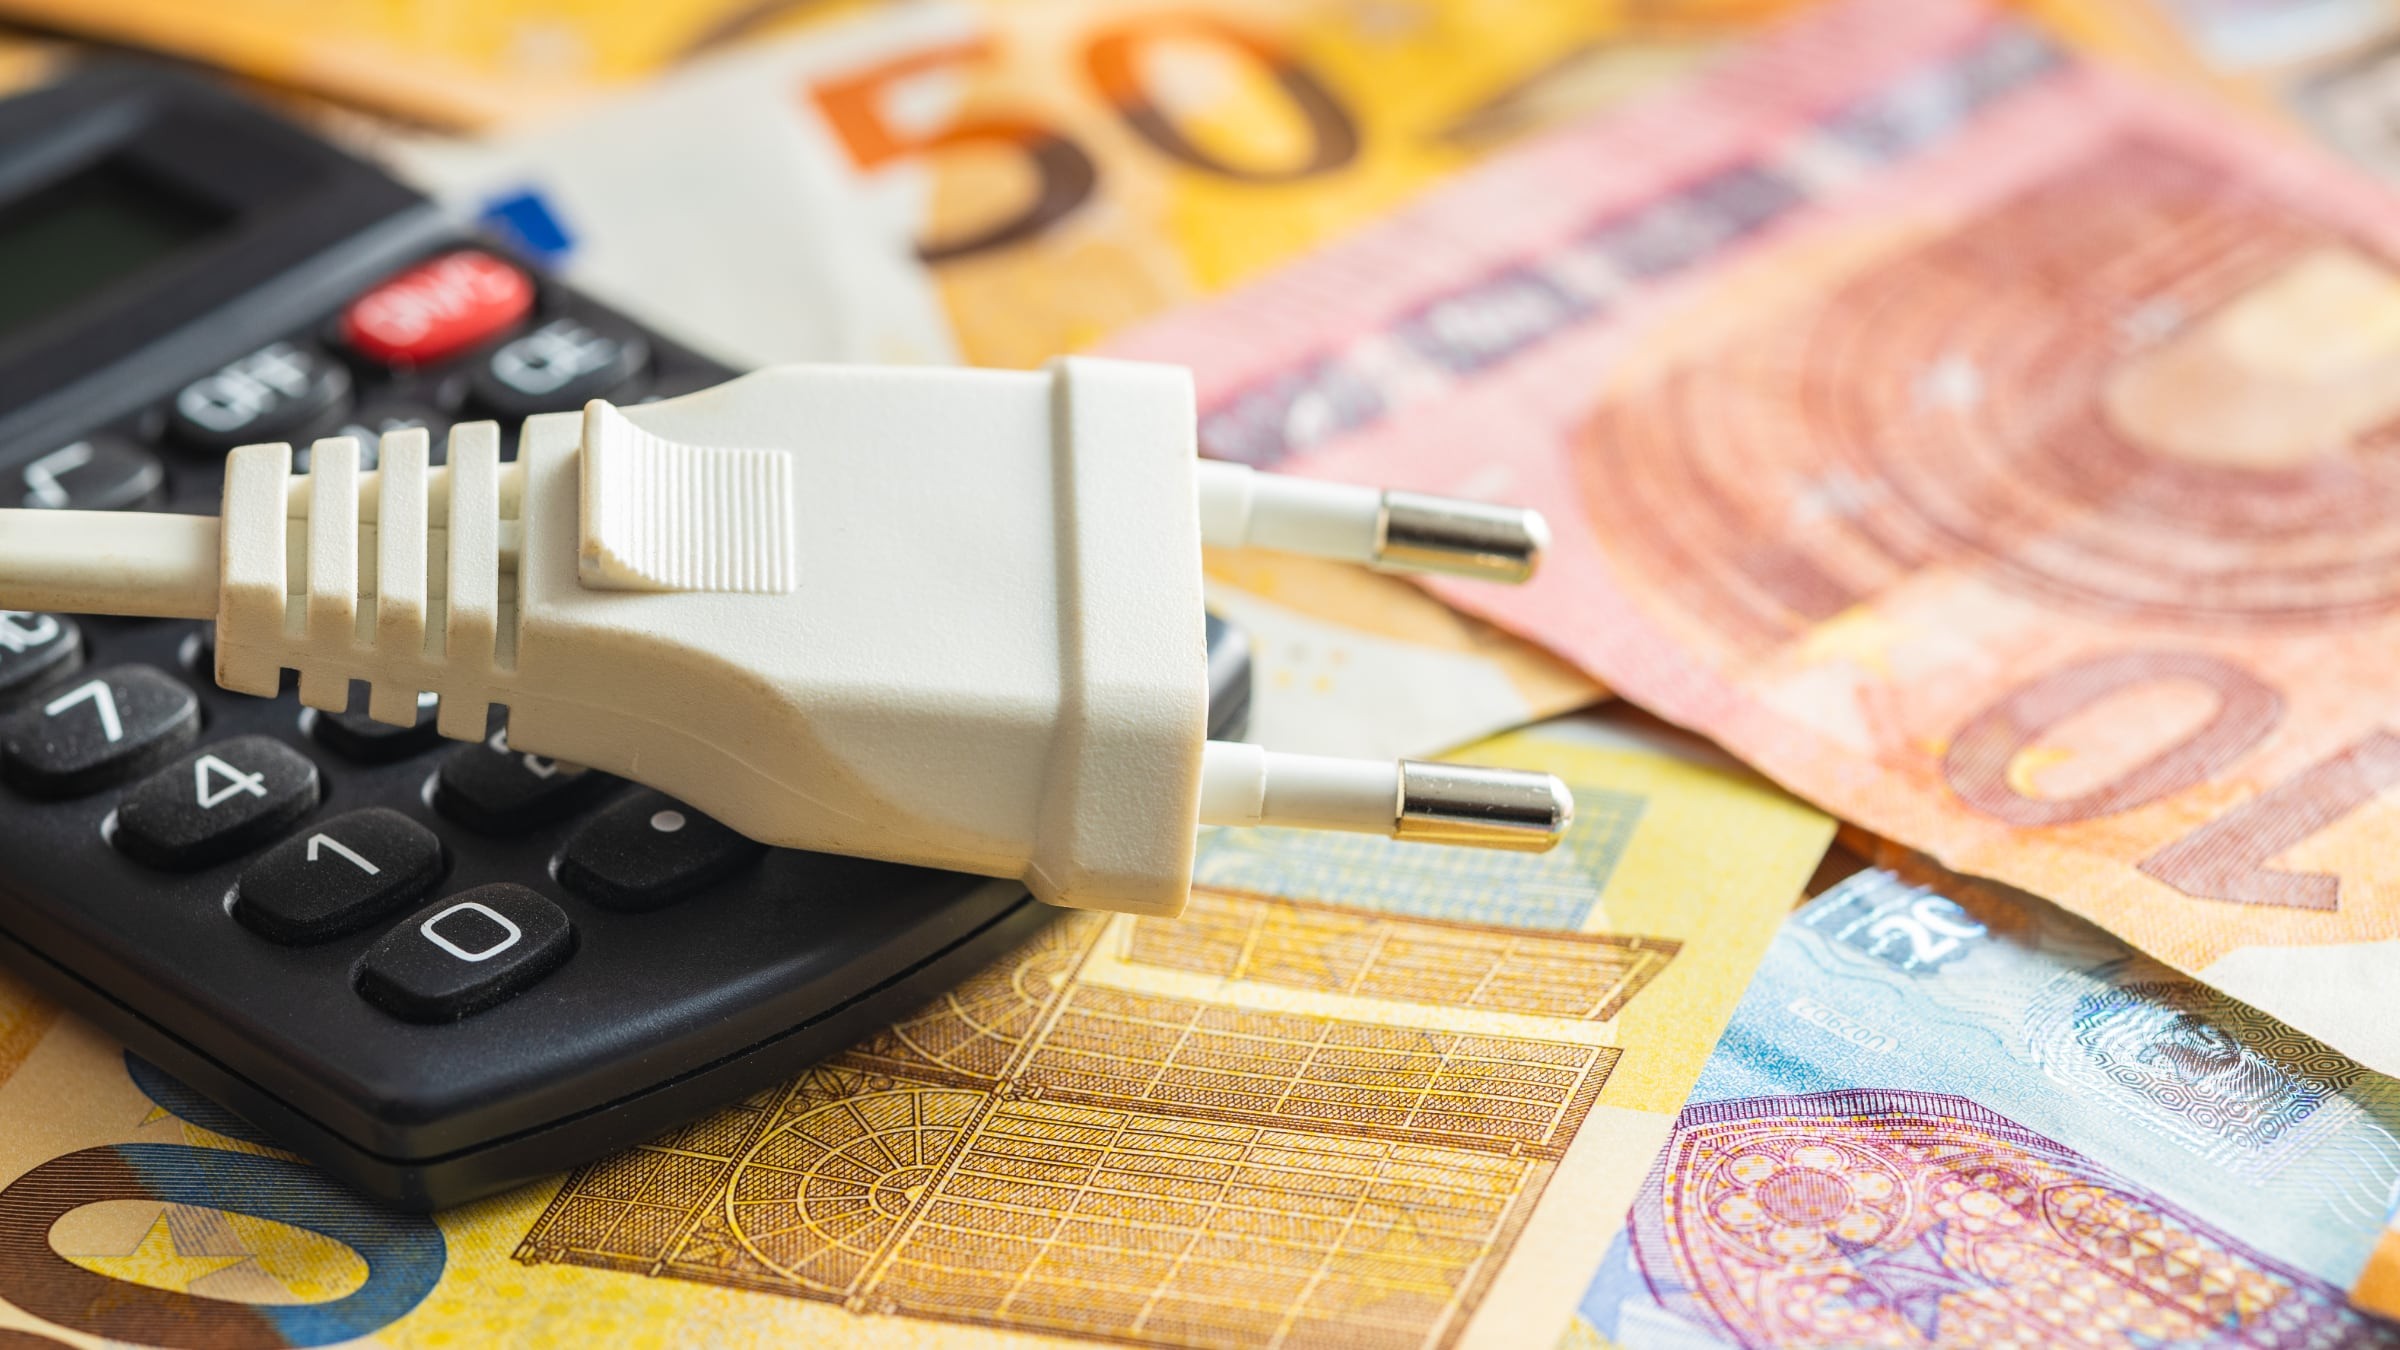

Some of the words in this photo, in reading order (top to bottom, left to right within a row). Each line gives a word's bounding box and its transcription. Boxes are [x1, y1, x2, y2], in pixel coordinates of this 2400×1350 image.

[808, 10, 1360, 264] 50
[176, 343, 310, 432] OFF
[44, 679, 124, 743] 7
[194, 753, 268, 809] 4
[306, 832, 381, 876] 1
[420, 902, 522, 962] 0
